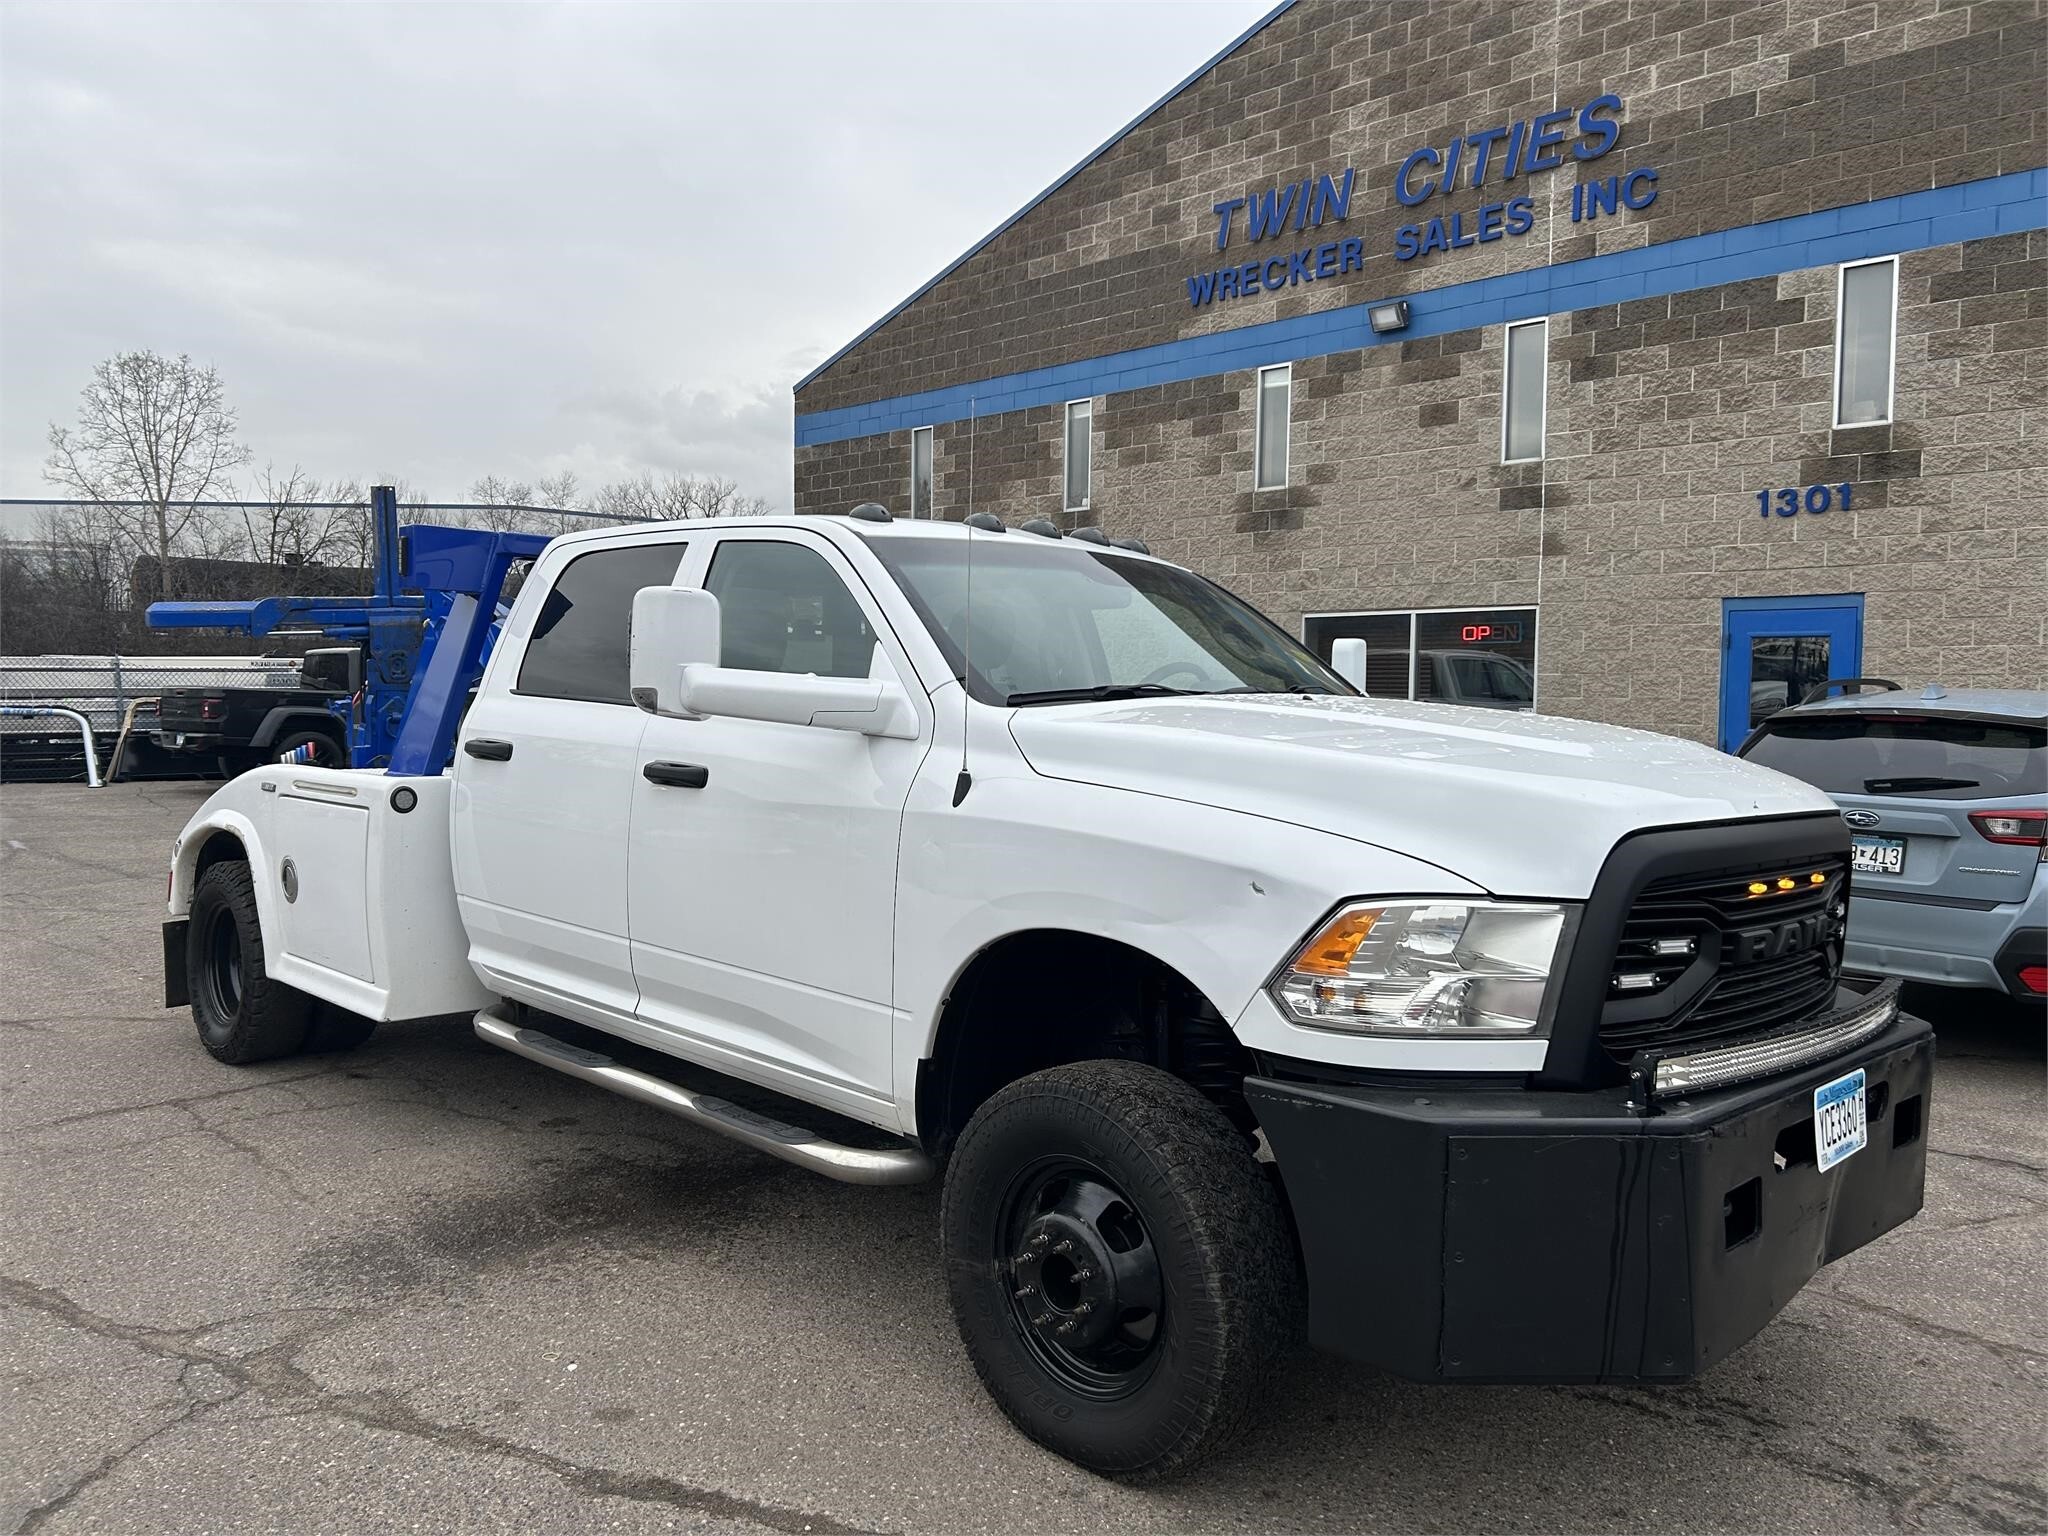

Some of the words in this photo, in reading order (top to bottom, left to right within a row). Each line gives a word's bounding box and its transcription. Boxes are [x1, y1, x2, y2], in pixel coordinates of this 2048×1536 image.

[1213, 167, 1356, 249] TWIN
[1396, 94, 1625, 206] CITIES
[1187, 237, 1363, 307] WRECKER
[1395, 196, 1534, 261] SALES
[1572, 167, 1659, 223] INC
[1756, 482, 1852, 518] 1301
[1462, 625, 1517, 641] OPEN
[1869, 846, 1900, 866] 413
[1736, 912, 1829, 962] RAM
